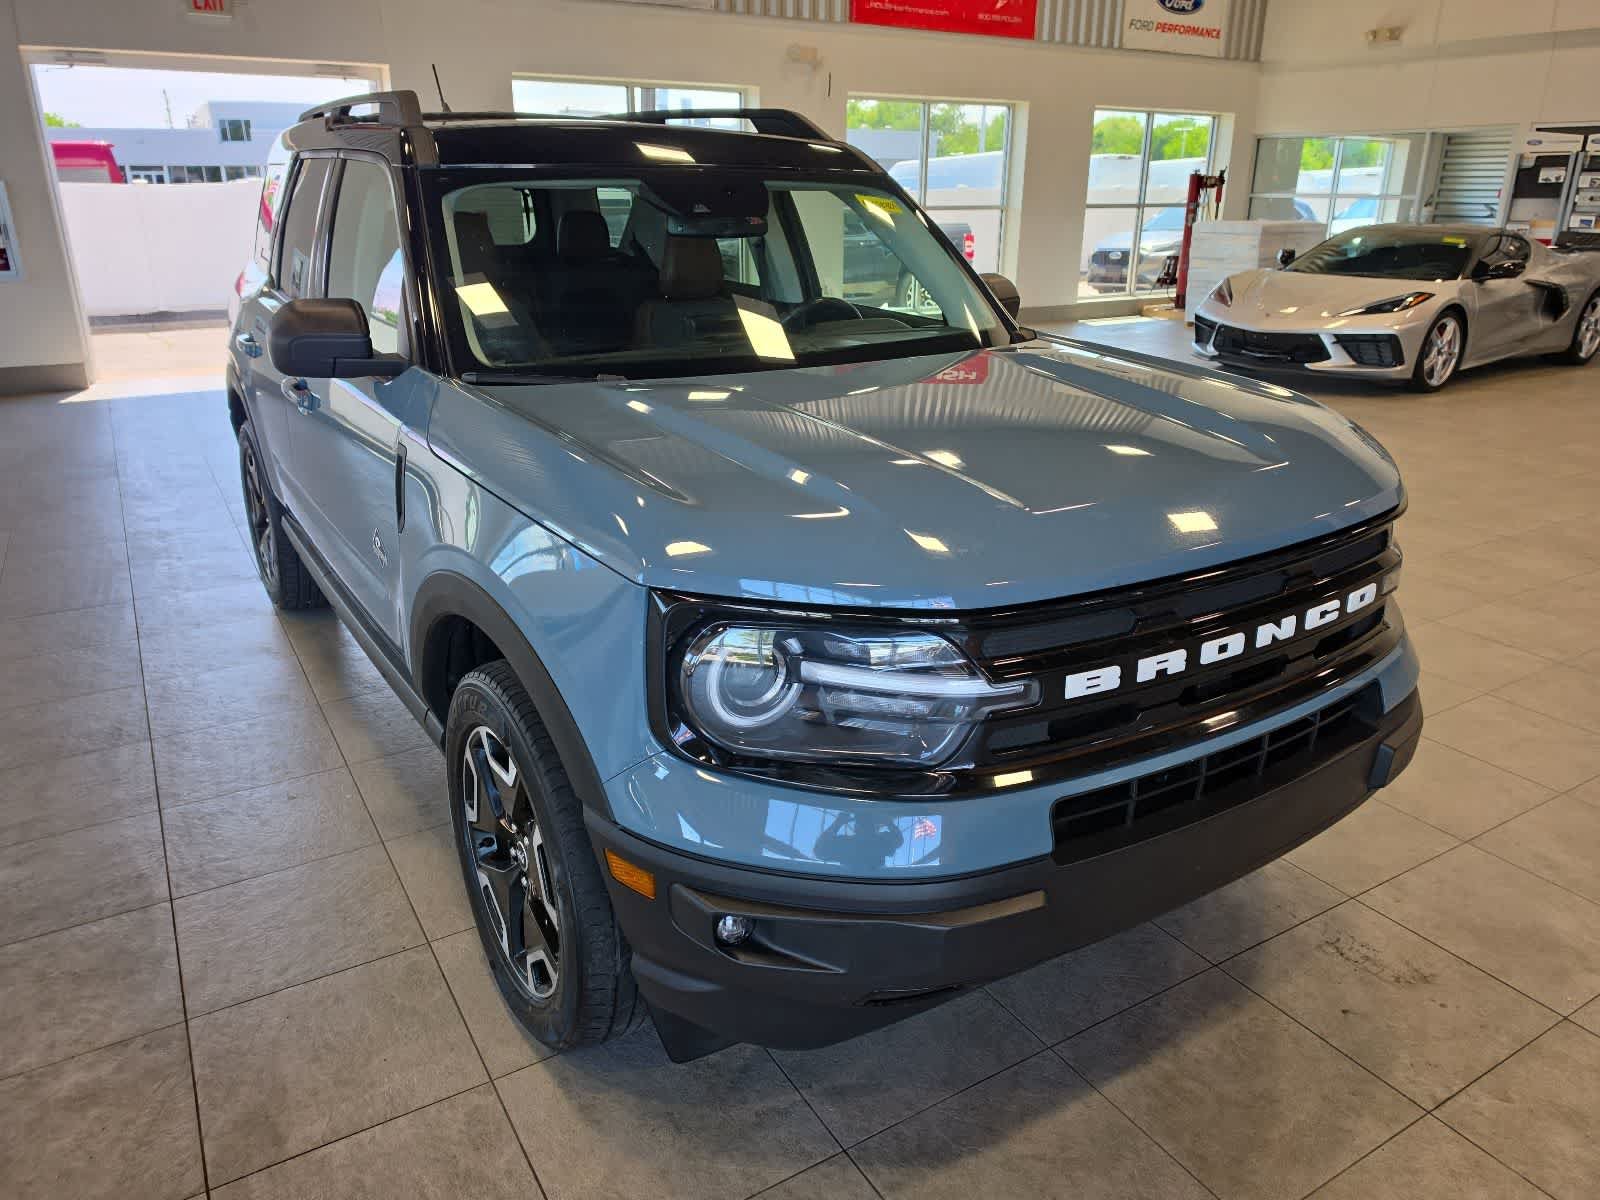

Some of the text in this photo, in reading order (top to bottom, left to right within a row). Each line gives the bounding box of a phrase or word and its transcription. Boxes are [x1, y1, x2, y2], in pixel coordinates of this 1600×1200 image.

[1128, 18, 1222, 39] FORD PERFORMANCE
[1064, 582, 1377, 699] BRONCO
